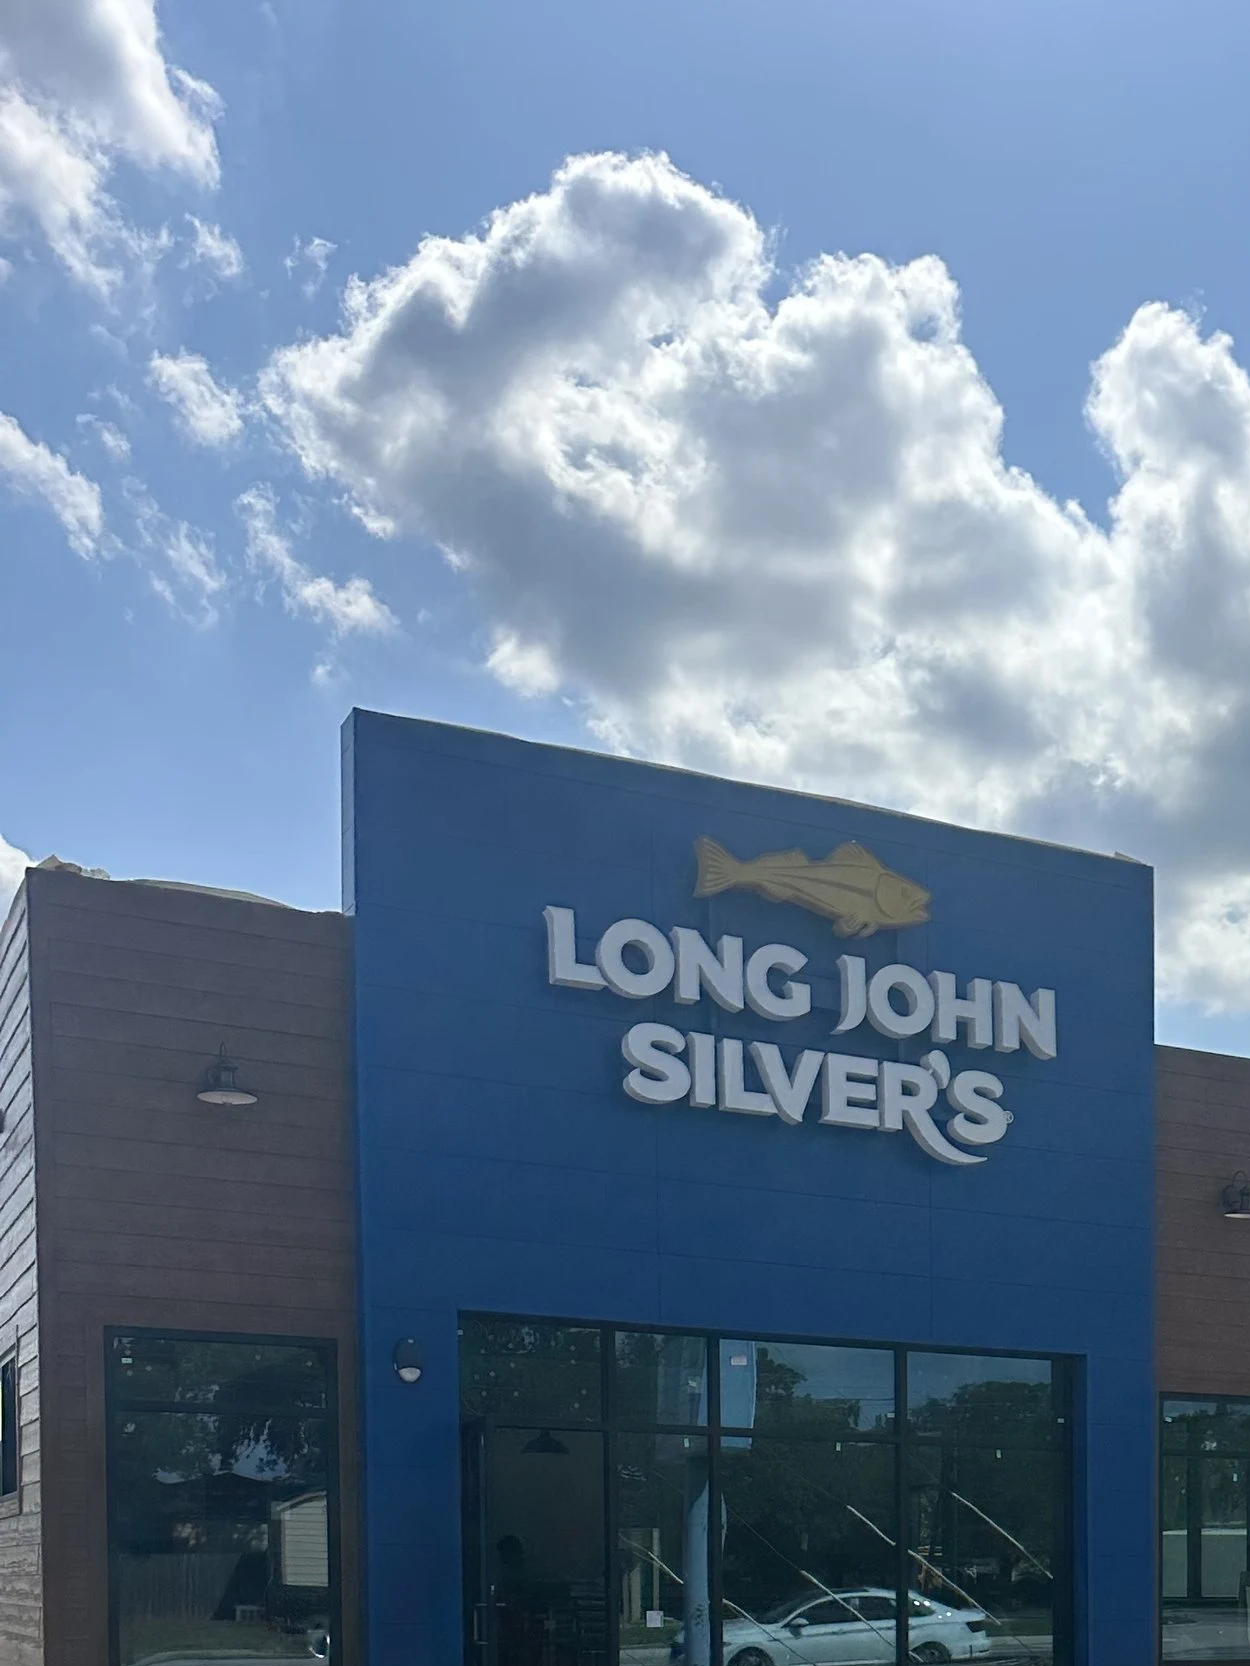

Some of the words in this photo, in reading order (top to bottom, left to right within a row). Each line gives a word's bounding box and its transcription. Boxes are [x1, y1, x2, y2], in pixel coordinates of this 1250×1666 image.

[543, 905, 811, 1022] LONG
[831, 955, 1057, 1060] JOHN
[621, 1022, 1009, 1166] SILVER'S
